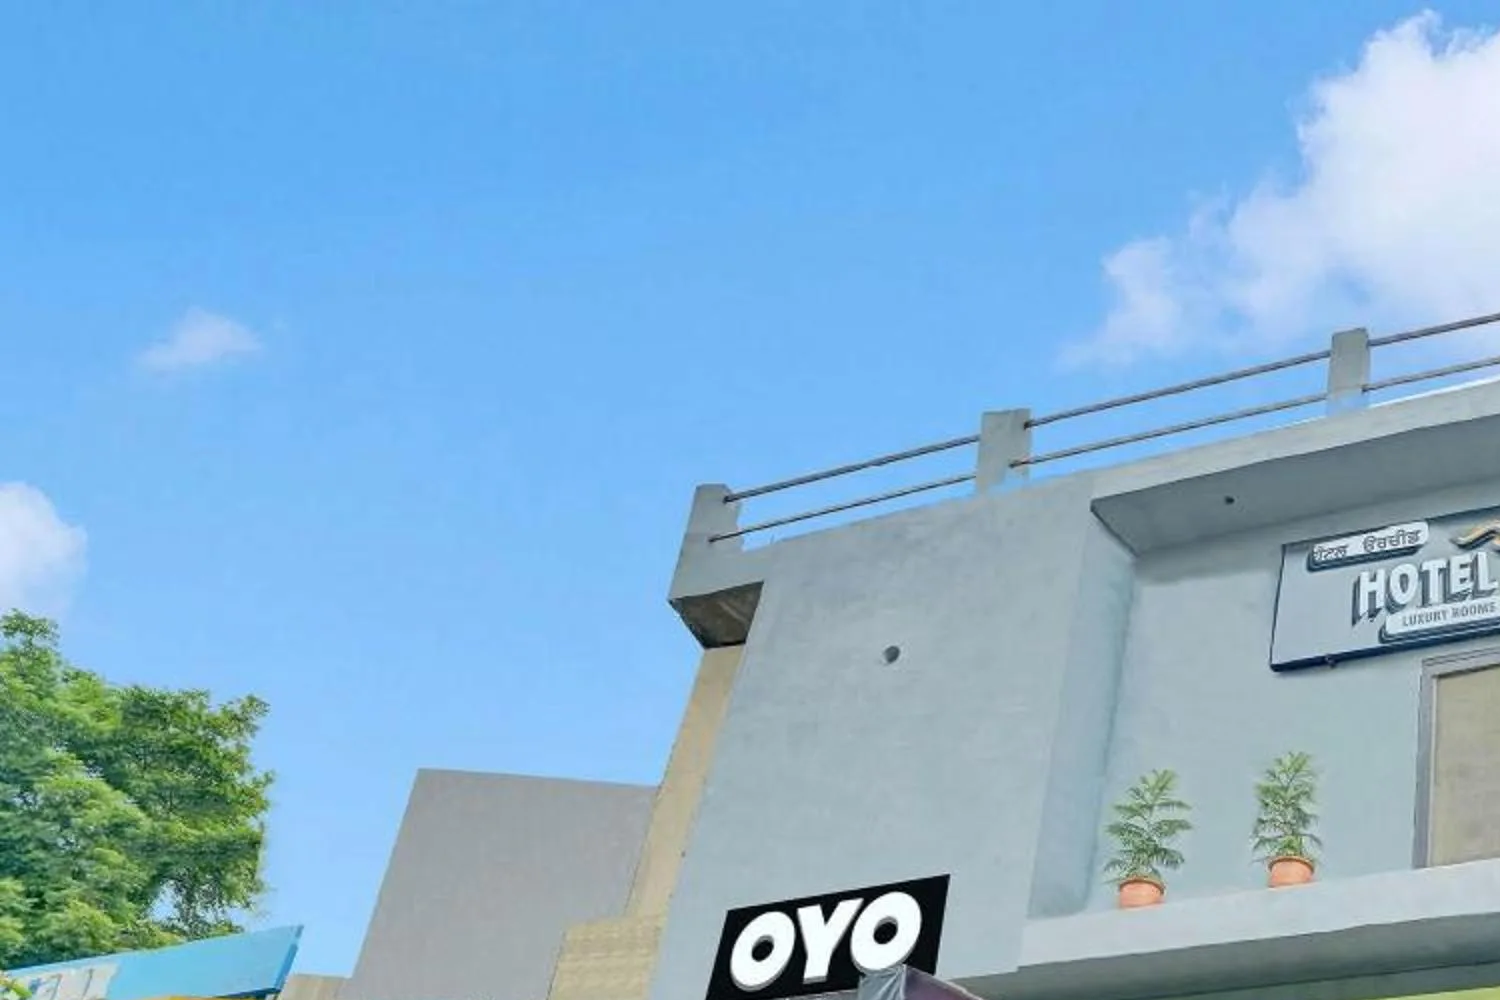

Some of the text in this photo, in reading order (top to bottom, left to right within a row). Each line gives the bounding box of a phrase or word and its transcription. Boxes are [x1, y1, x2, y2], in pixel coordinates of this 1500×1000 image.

[1357, 551, 1499, 616] HOTEL
[1402, 602, 1497, 628] LUXURY ROOMS
[730, 891, 923, 992] OYO
